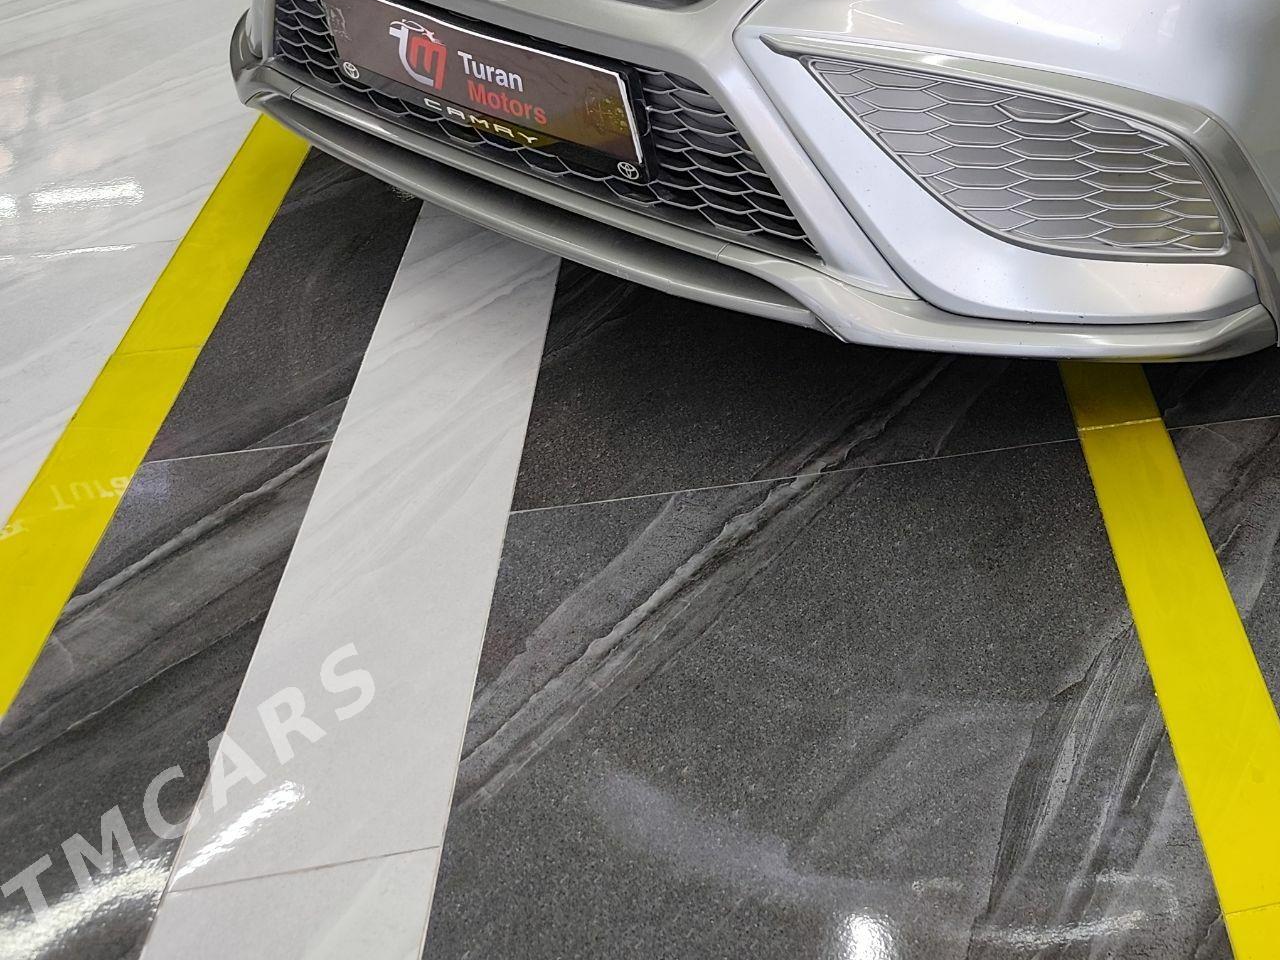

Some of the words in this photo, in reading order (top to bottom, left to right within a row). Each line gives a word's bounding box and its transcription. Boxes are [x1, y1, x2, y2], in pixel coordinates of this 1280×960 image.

[457, 50, 525, 93] Turan
[423, 97, 539, 144] CAMRY
[466, 79, 548, 126] Motors
